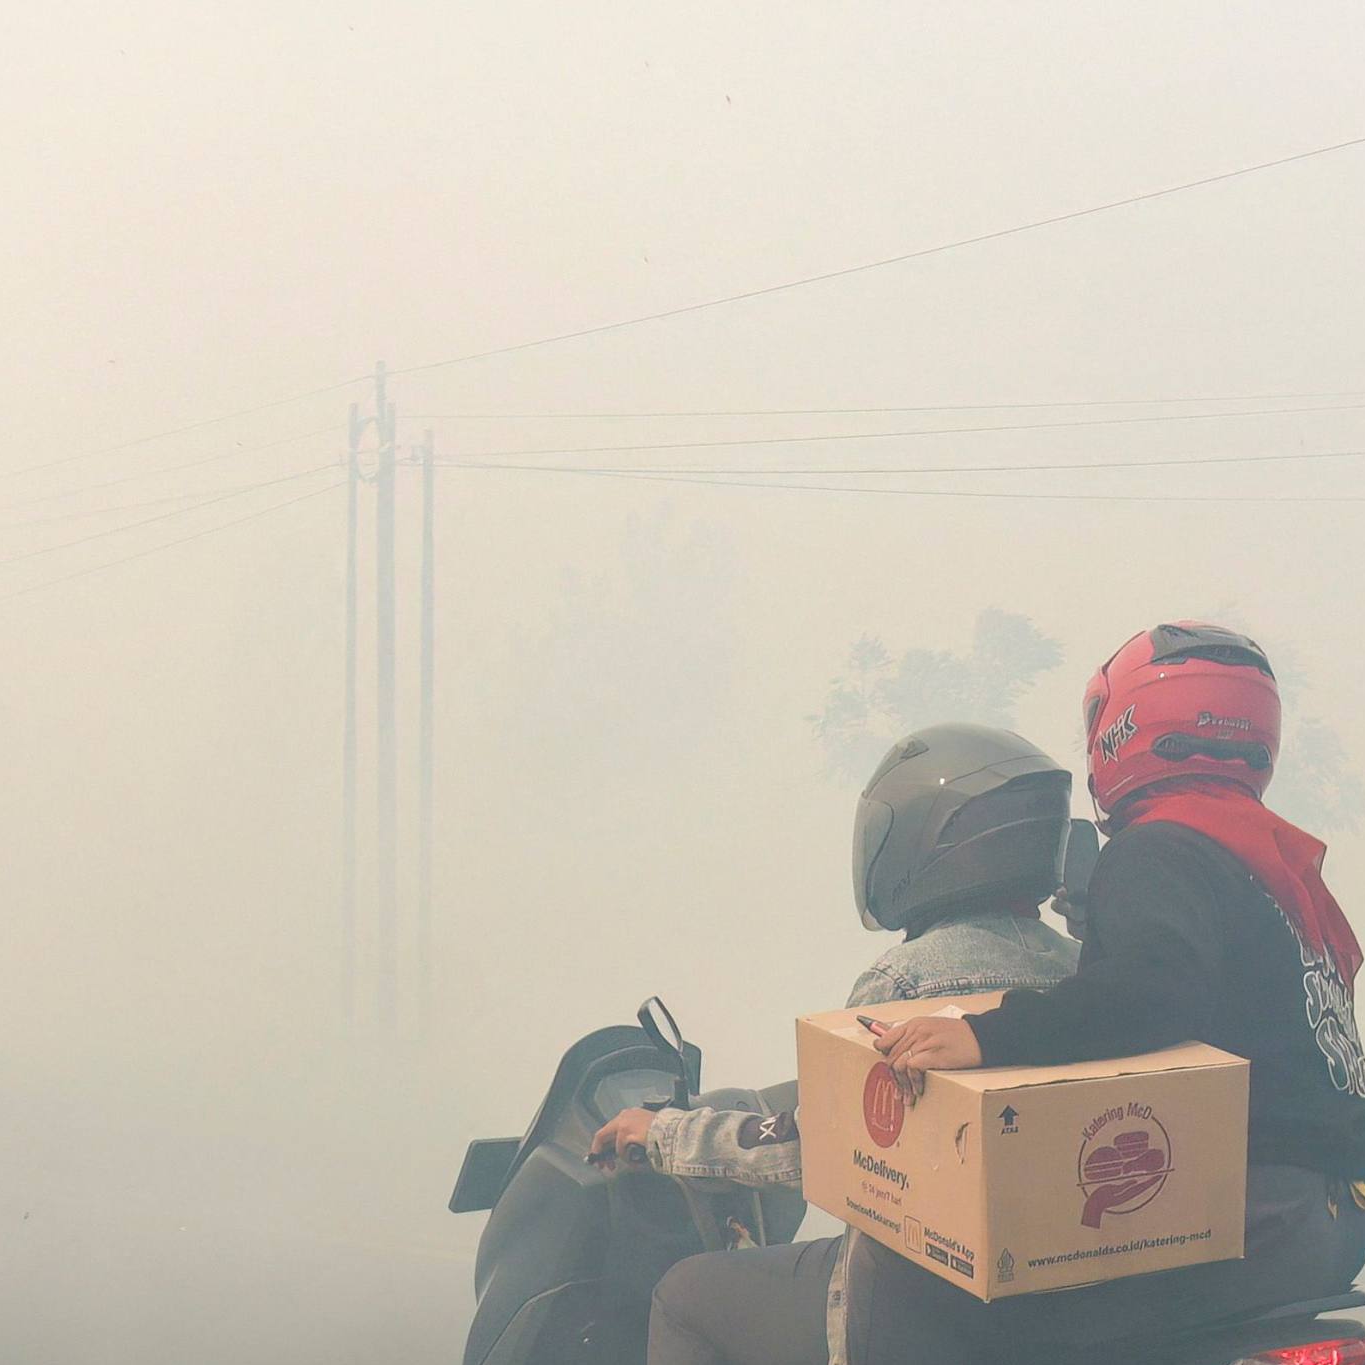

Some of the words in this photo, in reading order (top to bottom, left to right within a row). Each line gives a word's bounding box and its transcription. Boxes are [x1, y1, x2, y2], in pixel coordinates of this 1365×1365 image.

[1099, 704, 1138, 764] NHK
[1082, 1104, 1125, 1140] Katering
[1126, 1102, 1153, 1120] McD
[1027, 1229, 1212, 1268] www.mcdonalds.co.id/katering-mcd
